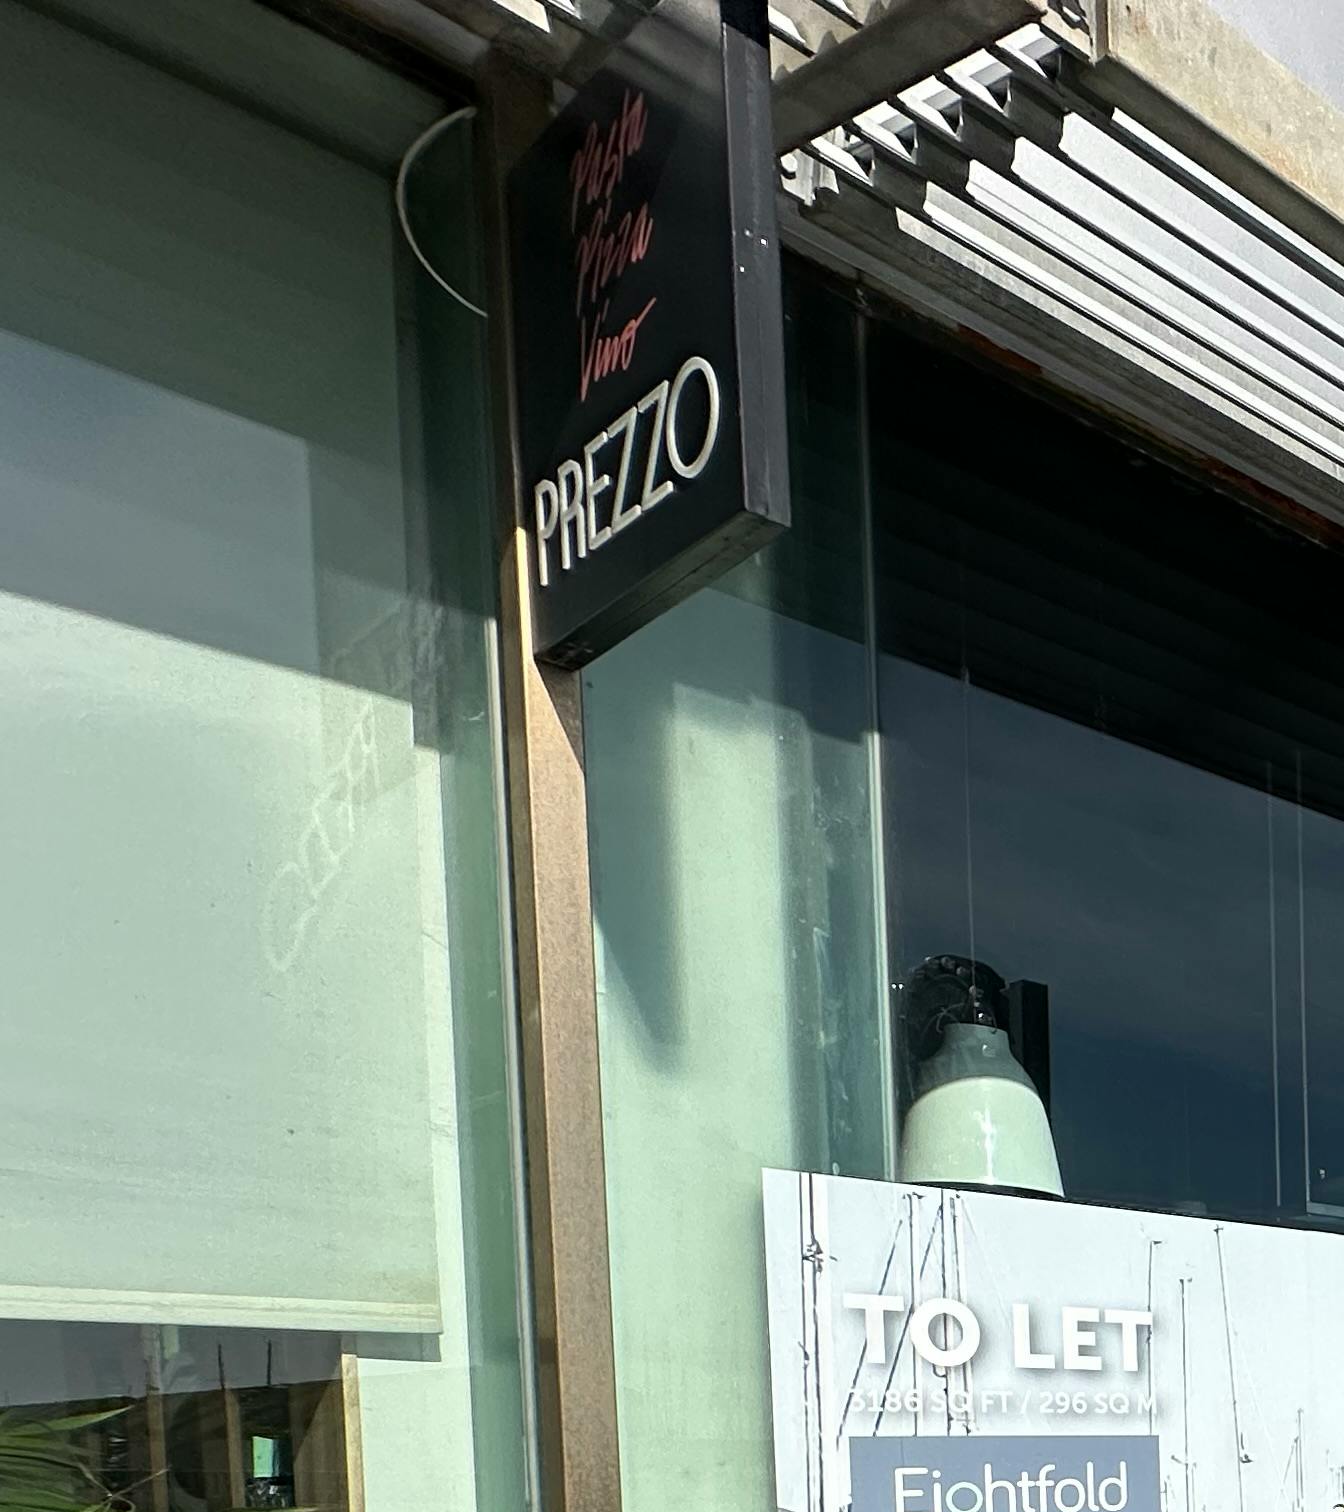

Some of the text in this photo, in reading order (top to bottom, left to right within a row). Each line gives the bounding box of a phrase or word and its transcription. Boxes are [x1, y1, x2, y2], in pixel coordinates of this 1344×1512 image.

[570, 87, 648, 236] Pasta
[575, 198, 653, 318] Pizza
[580, 297, 657, 403] Vino
[535, 355, 720, 587] PREZZO
[843, 1294, 1154, 1372] TO LET
[930, 1387, 971, 1414] SQ
[981, 1390, 1014, 1414] FT
[1039, 1390, 1089, 1414] 296
[1094, 1391, 1131, 1415] SQ
[1137, 1392, 1158, 1415] M
